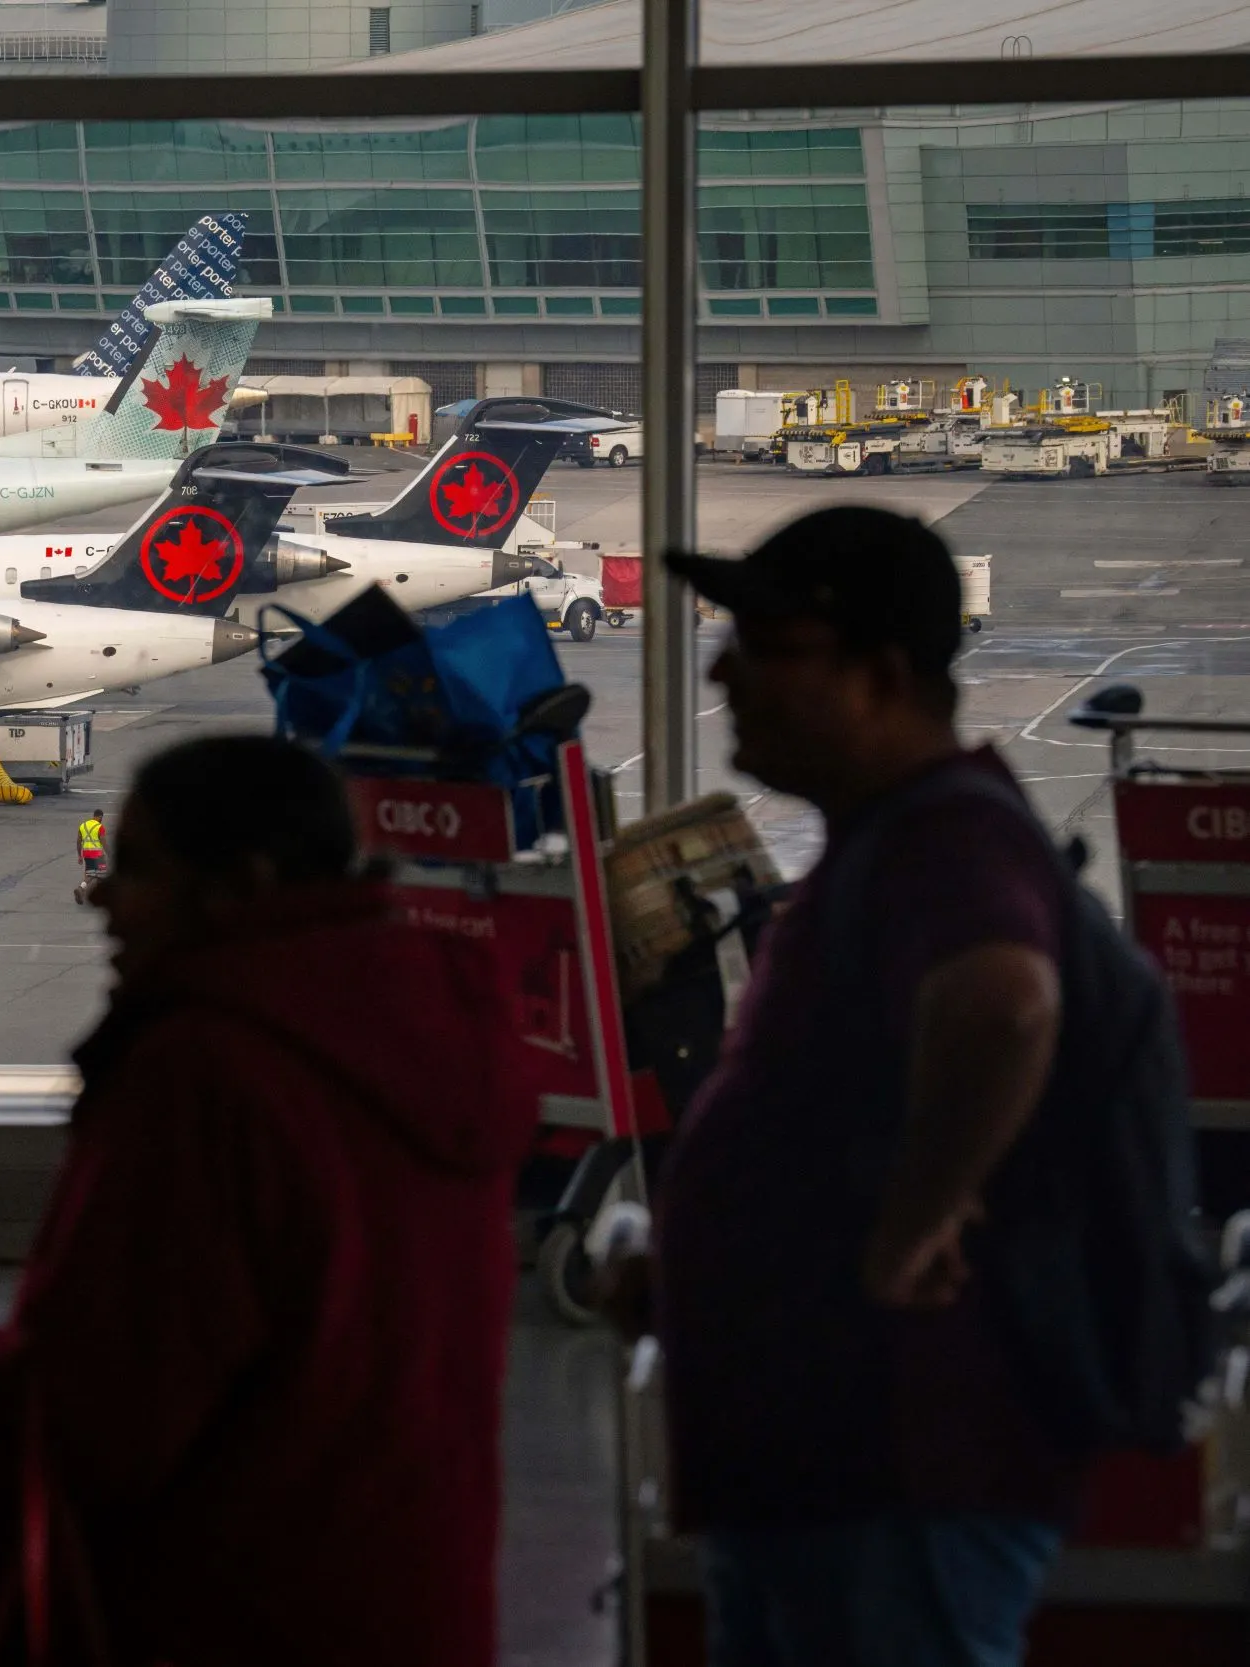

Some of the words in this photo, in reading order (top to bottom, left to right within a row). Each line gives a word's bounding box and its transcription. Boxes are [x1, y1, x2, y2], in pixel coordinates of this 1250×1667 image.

[198, 215, 236, 247] porter
[177, 240, 206, 267] orter
[198, 238, 236, 272] porter
[170, 260, 206, 293] porter
[121, 310, 148, 336] orter
[464, 433, 480, 442] 722
[0, 487, 55, 499] C-GJZN
[181, 486, 198, 496] 708
[9, 728, 26, 738] TLD
